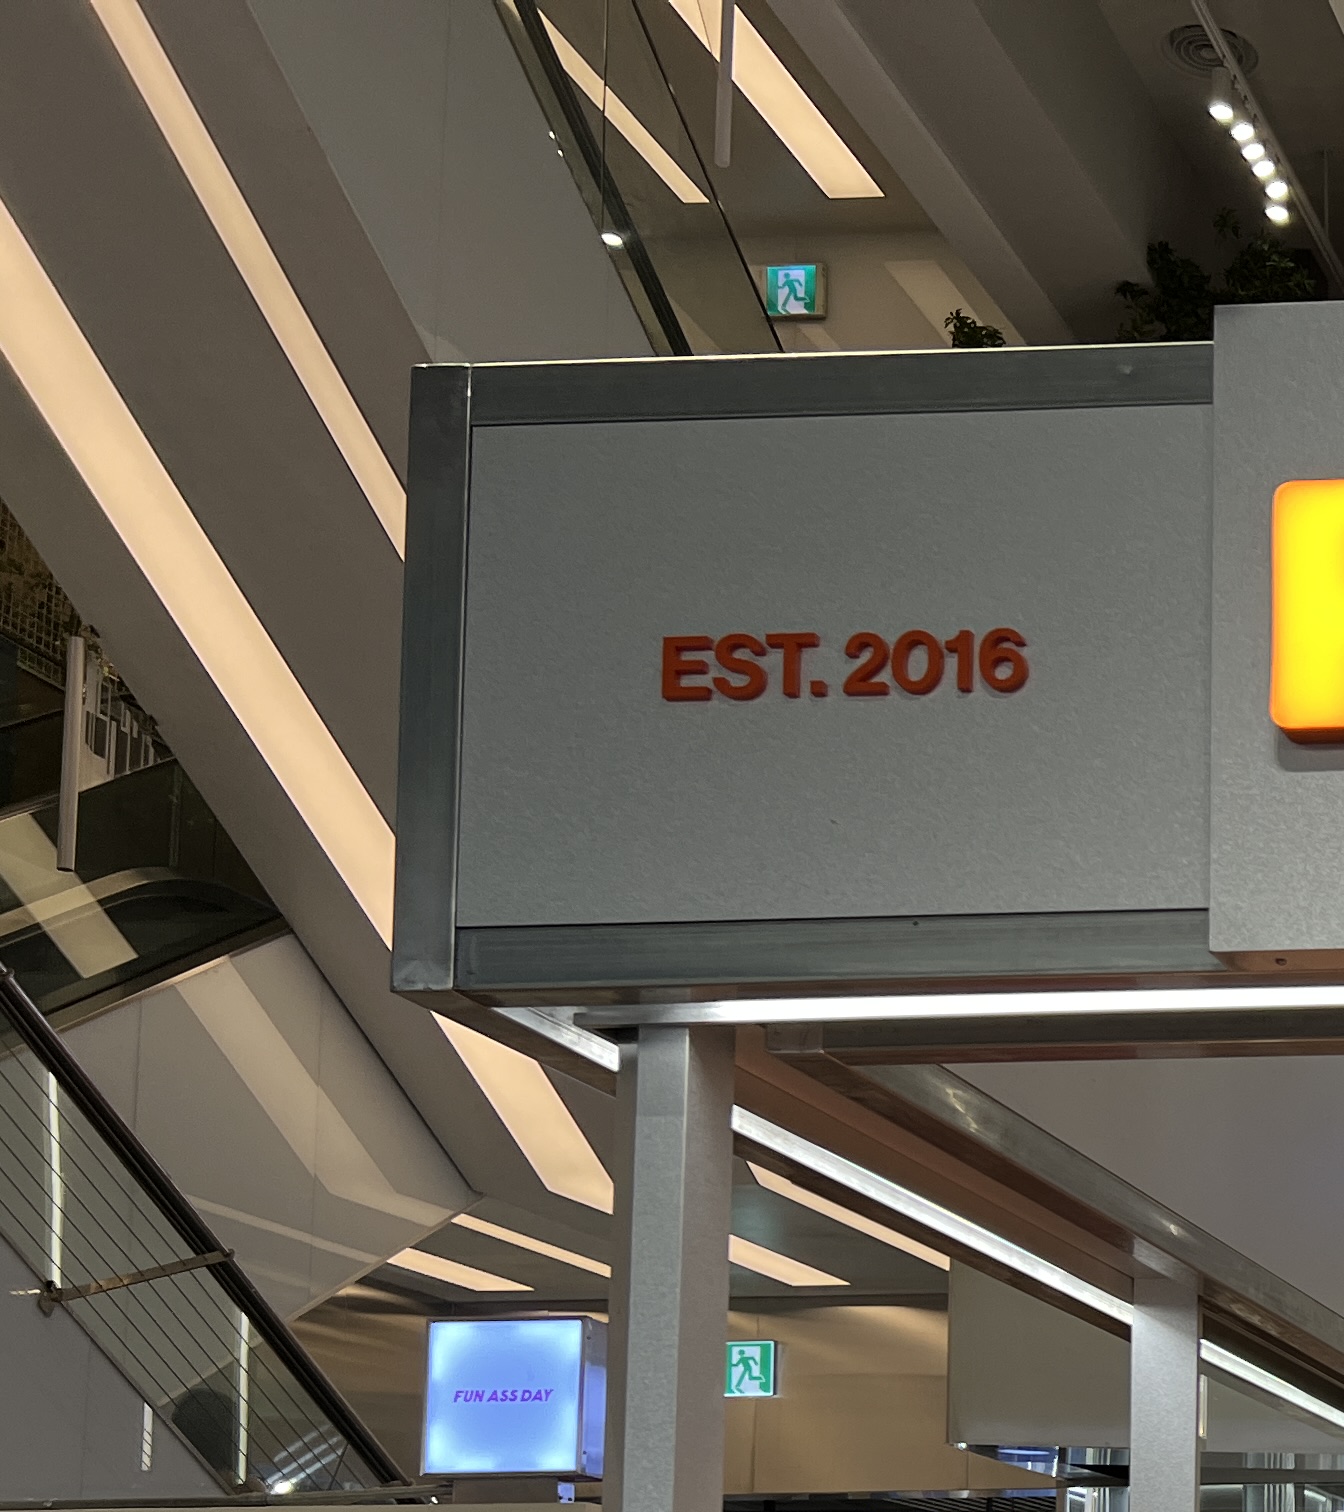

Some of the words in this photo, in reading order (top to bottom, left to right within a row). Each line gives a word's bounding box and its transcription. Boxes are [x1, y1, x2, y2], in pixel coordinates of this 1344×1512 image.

[453, 1390, 485, 1403] FUN
[487, 1389, 519, 1402] ASS
[520, 1388, 554, 1402] DAY
